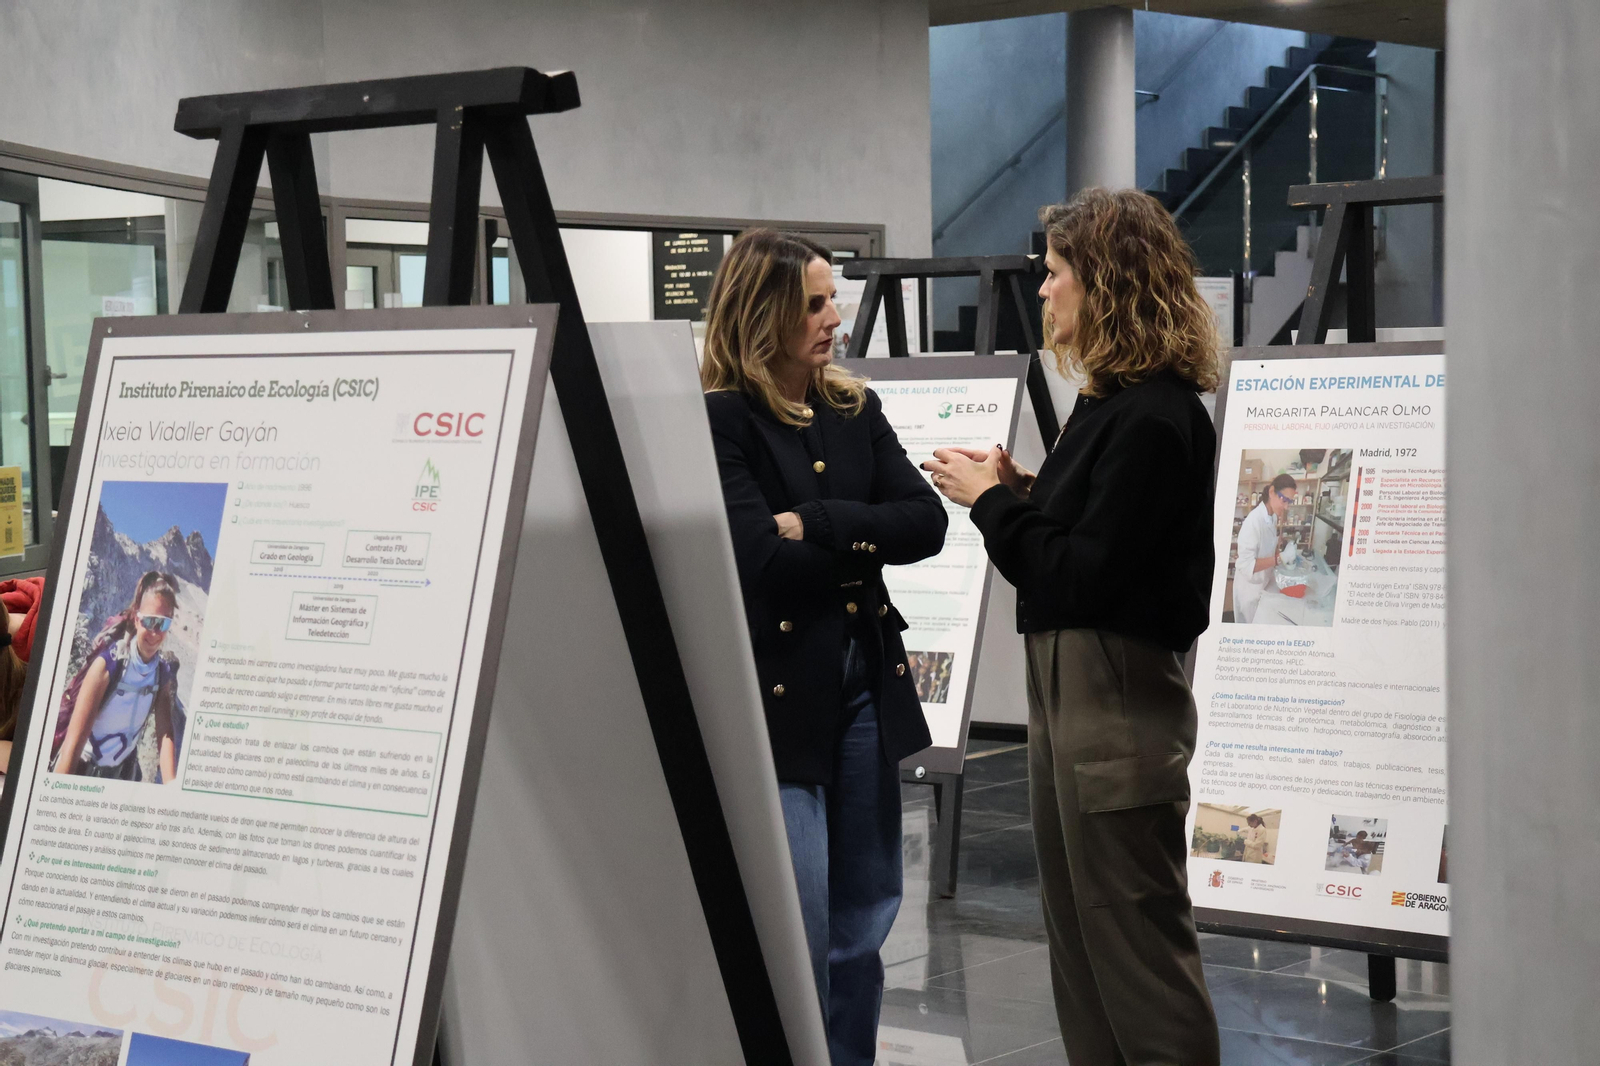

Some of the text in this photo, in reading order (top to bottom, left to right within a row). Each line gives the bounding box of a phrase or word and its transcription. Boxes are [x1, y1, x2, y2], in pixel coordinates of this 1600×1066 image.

[1236, 374, 1446, 391] ESTACIÓN EXPERIMENTAL DE
[119, 378, 379, 402] Instituto Pirenaico de Ecología (CSIC)
[932, 386, 944, 394] DEI
[946, 386, 968, 394] (CSIC)
[955, 403, 998, 413] EEAD
[1246, 404, 1431, 418] MARGARITA PALANCAR OLMO
[413, 412, 486, 437] CSIC
[1244, 421, 1435, 431] PERSONAL LABORAL FIJO (APOYO A LA INVESTIGACIÓN)
[103, 420, 278, 447] Ixeia Vidaller Gayán
[1360, 448, 1416, 458] Madrid, 1972
[98, 450, 321, 476] Investigadora en formación
[415, 485, 439, 498] IPE
[412, 502, 438, 512] CSIC
[365, 544, 393, 552] Contrato
[260, 552, 277, 560] Grado
[287, 553, 314, 562] Geología
[346, 556, 423, 566] Desarrollo Tesis Doctoral
[299, 603, 320, 612] Máster
[330, 605, 357, 614] Sistemas
[358, 607, 367, 615] de
[293, 616, 329, 625] Información
[331, 618, 363, 628] Geográfica
[308, 629, 349, 639] Teledetección
[1219, 637, 1231, 645] ¿De
[1232, 637, 1243, 646] qué
[1256, 639, 1275, 647] ocupo
[1275, 649, 1307, 657] Absorción
[1216, 665, 1235, 674] Apoyo
[1240, 666, 1287, 675] mantenimiento
[1212, 692, 1233, 701] ¿Cómo
[1234, 693, 1256, 701] facilita
[1266, 695, 1289, 704] trabajo
[1298, 696, 1345, 707] investigación?
[205, 719, 249, 730] ¿Qué estudio?
[193, 734, 201, 742] Mi
[203, 735, 242, 748] investigación
[244, 738, 259, 747] trata
[262, 740, 271, 748] de
[273, 741, 296, 750] enlazar
[299, 744, 309, 752] los
[312, 745, 339, 754] cambios
[342, 749, 354, 758] que
[357, 749, 376, 758] están
[379, 751, 411, 761] sufriendo
[1206, 741, 1220, 750] ¿Por
[1221, 742, 1233, 751] qué
[1245, 743, 1267, 751] resulta
[1268, 745, 1305, 753] interesante
[1316, 748, 1343, 757] trabajo?
[190, 748, 221, 759] actualidad
[222, 752, 232, 760] los
[233, 753, 262, 765] glaciares
[276, 757, 283, 765] el
[285, 758, 319, 770] paleoclima
[321, 761, 330, 769] de
[331, 762, 341, 770] los
[343, 763, 367, 773] últimos
[369, 766, 387, 775] miles
[389, 768, 398, 776] de
[400, 769, 418, 778] años.
[422, 771, 431, 779] Es
[72, 782, 78, 791] lo
[79, 783, 106, 793] estudio?
[36, 854, 50, 865] ¿Por
[71, 859, 106, 870] interesante
[106, 863, 136, 874] dedicarse
[143, 868, 159, 877] ello?
[1326, 884, 1362, 898] CSIC
[1406, 892, 1447, 903] GOBIERNO
[1405, 900, 1416, 908] DE
[23, 919, 39, 930] ¿Qué
[39, 921, 66, 934] pretendo
[67, 925, 89, 937] aportar
[95, 929, 104, 937] mi
[104, 932, 126, 942] campo
[126, 933, 135, 941] de
[88, 952, 287, 1053] CSIC
